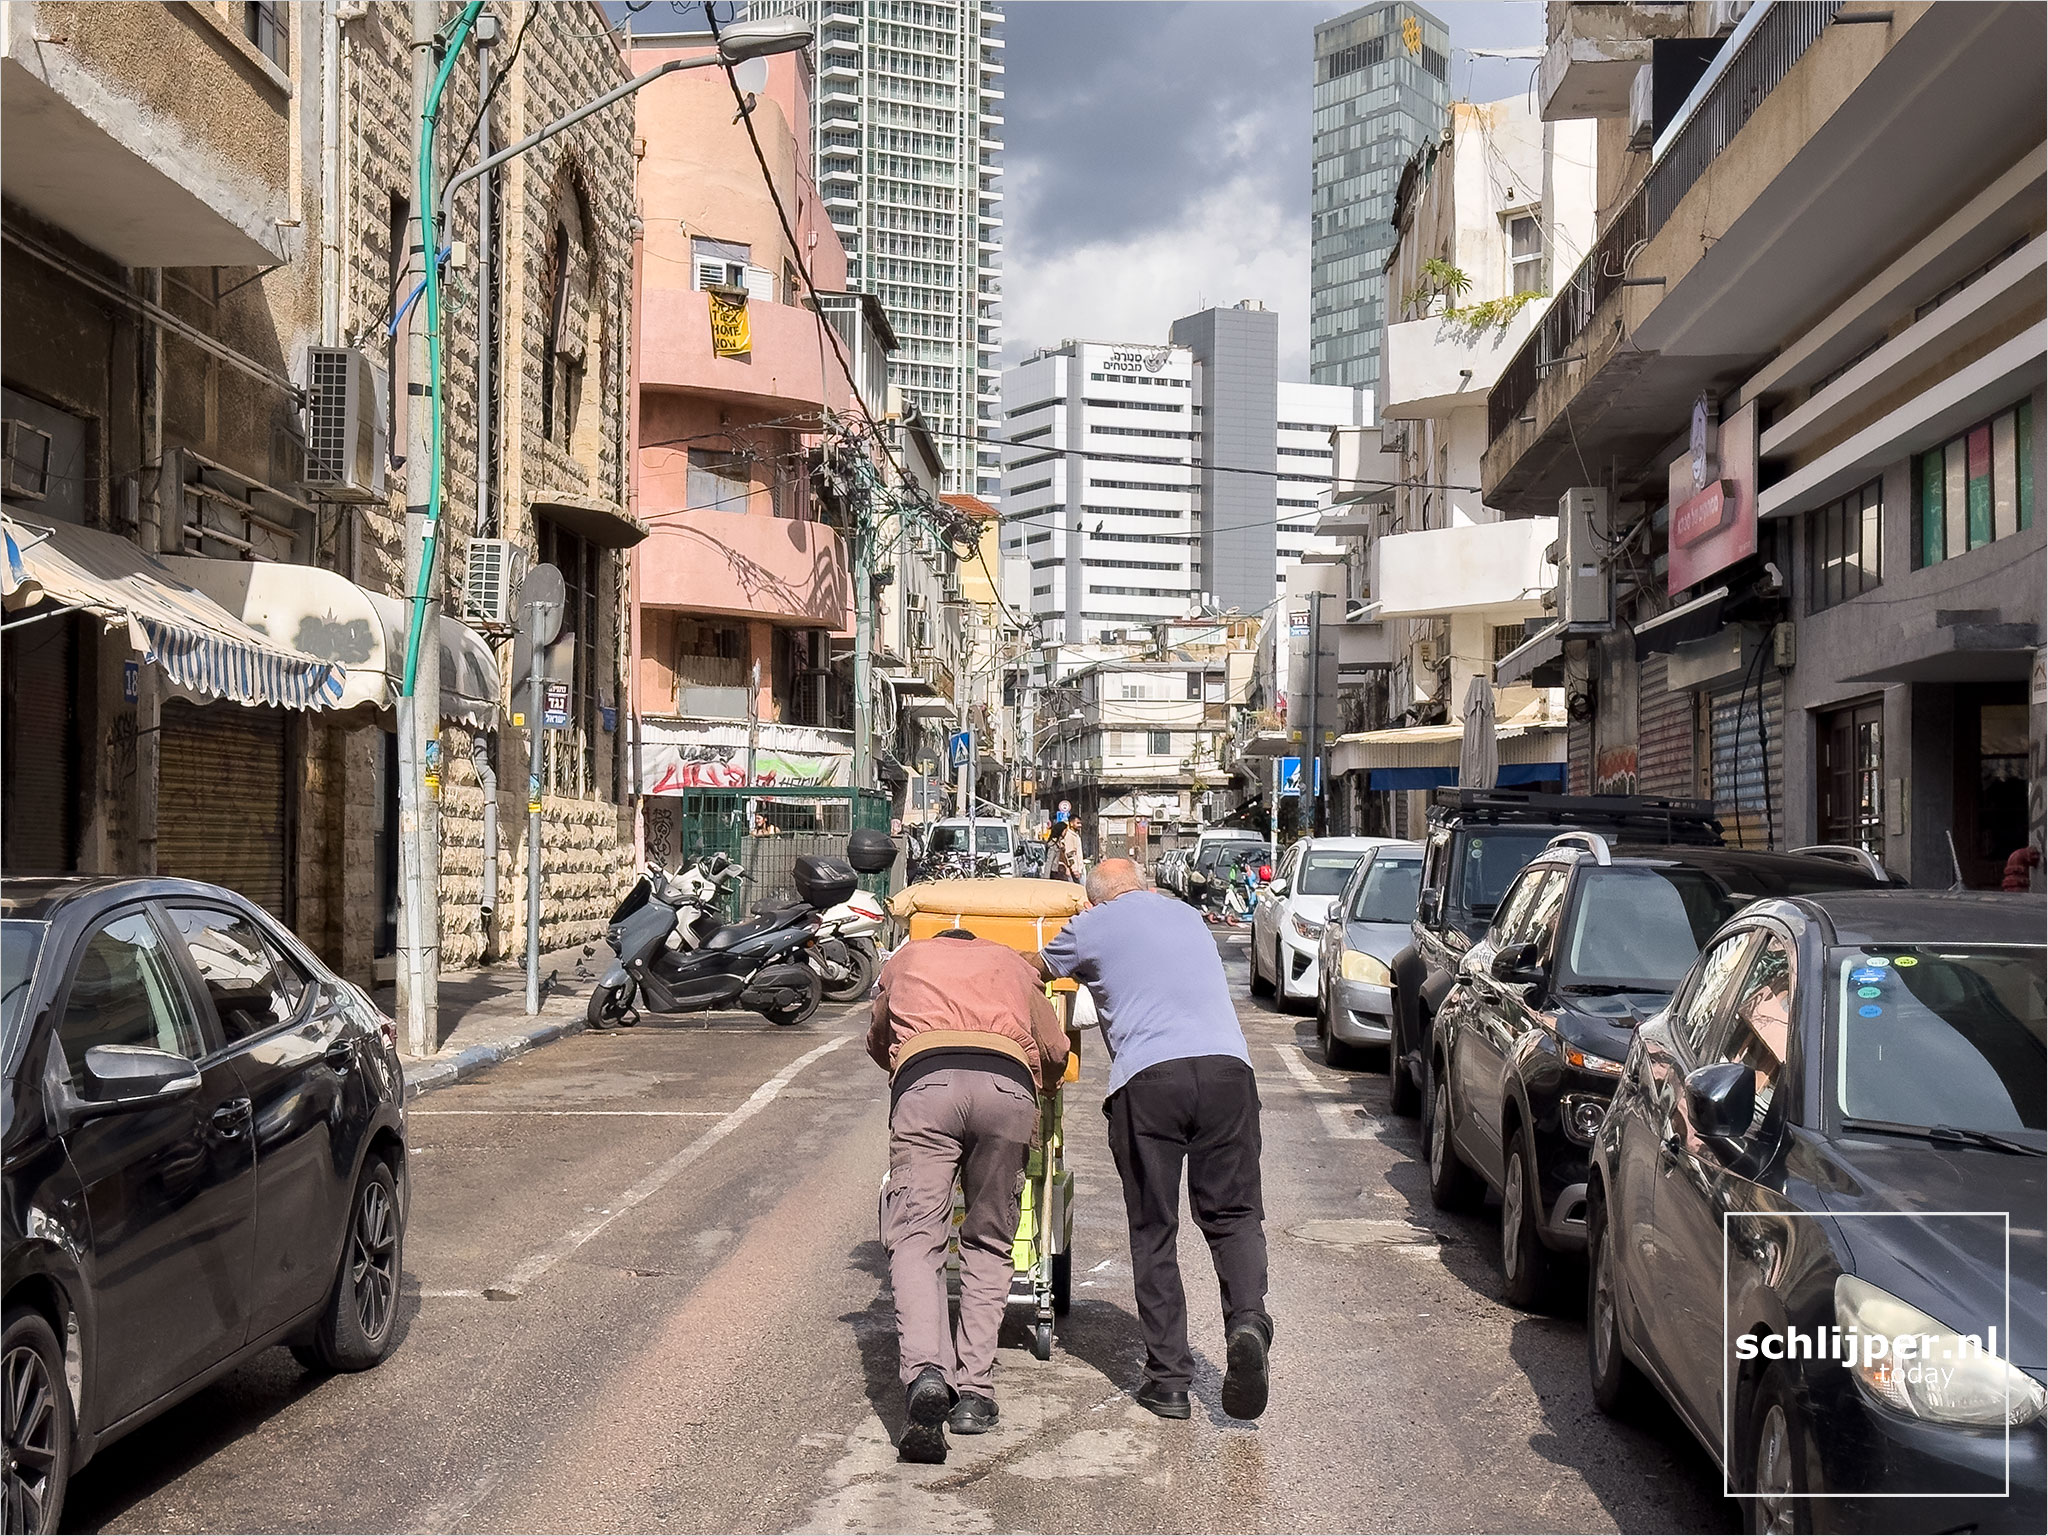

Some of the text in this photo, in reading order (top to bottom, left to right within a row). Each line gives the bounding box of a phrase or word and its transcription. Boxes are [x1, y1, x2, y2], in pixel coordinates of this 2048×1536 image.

[1103, 361, 1142, 371] מבטחים
[125, 670, 138, 696] 18
[548, 697, 565, 709] נגד
